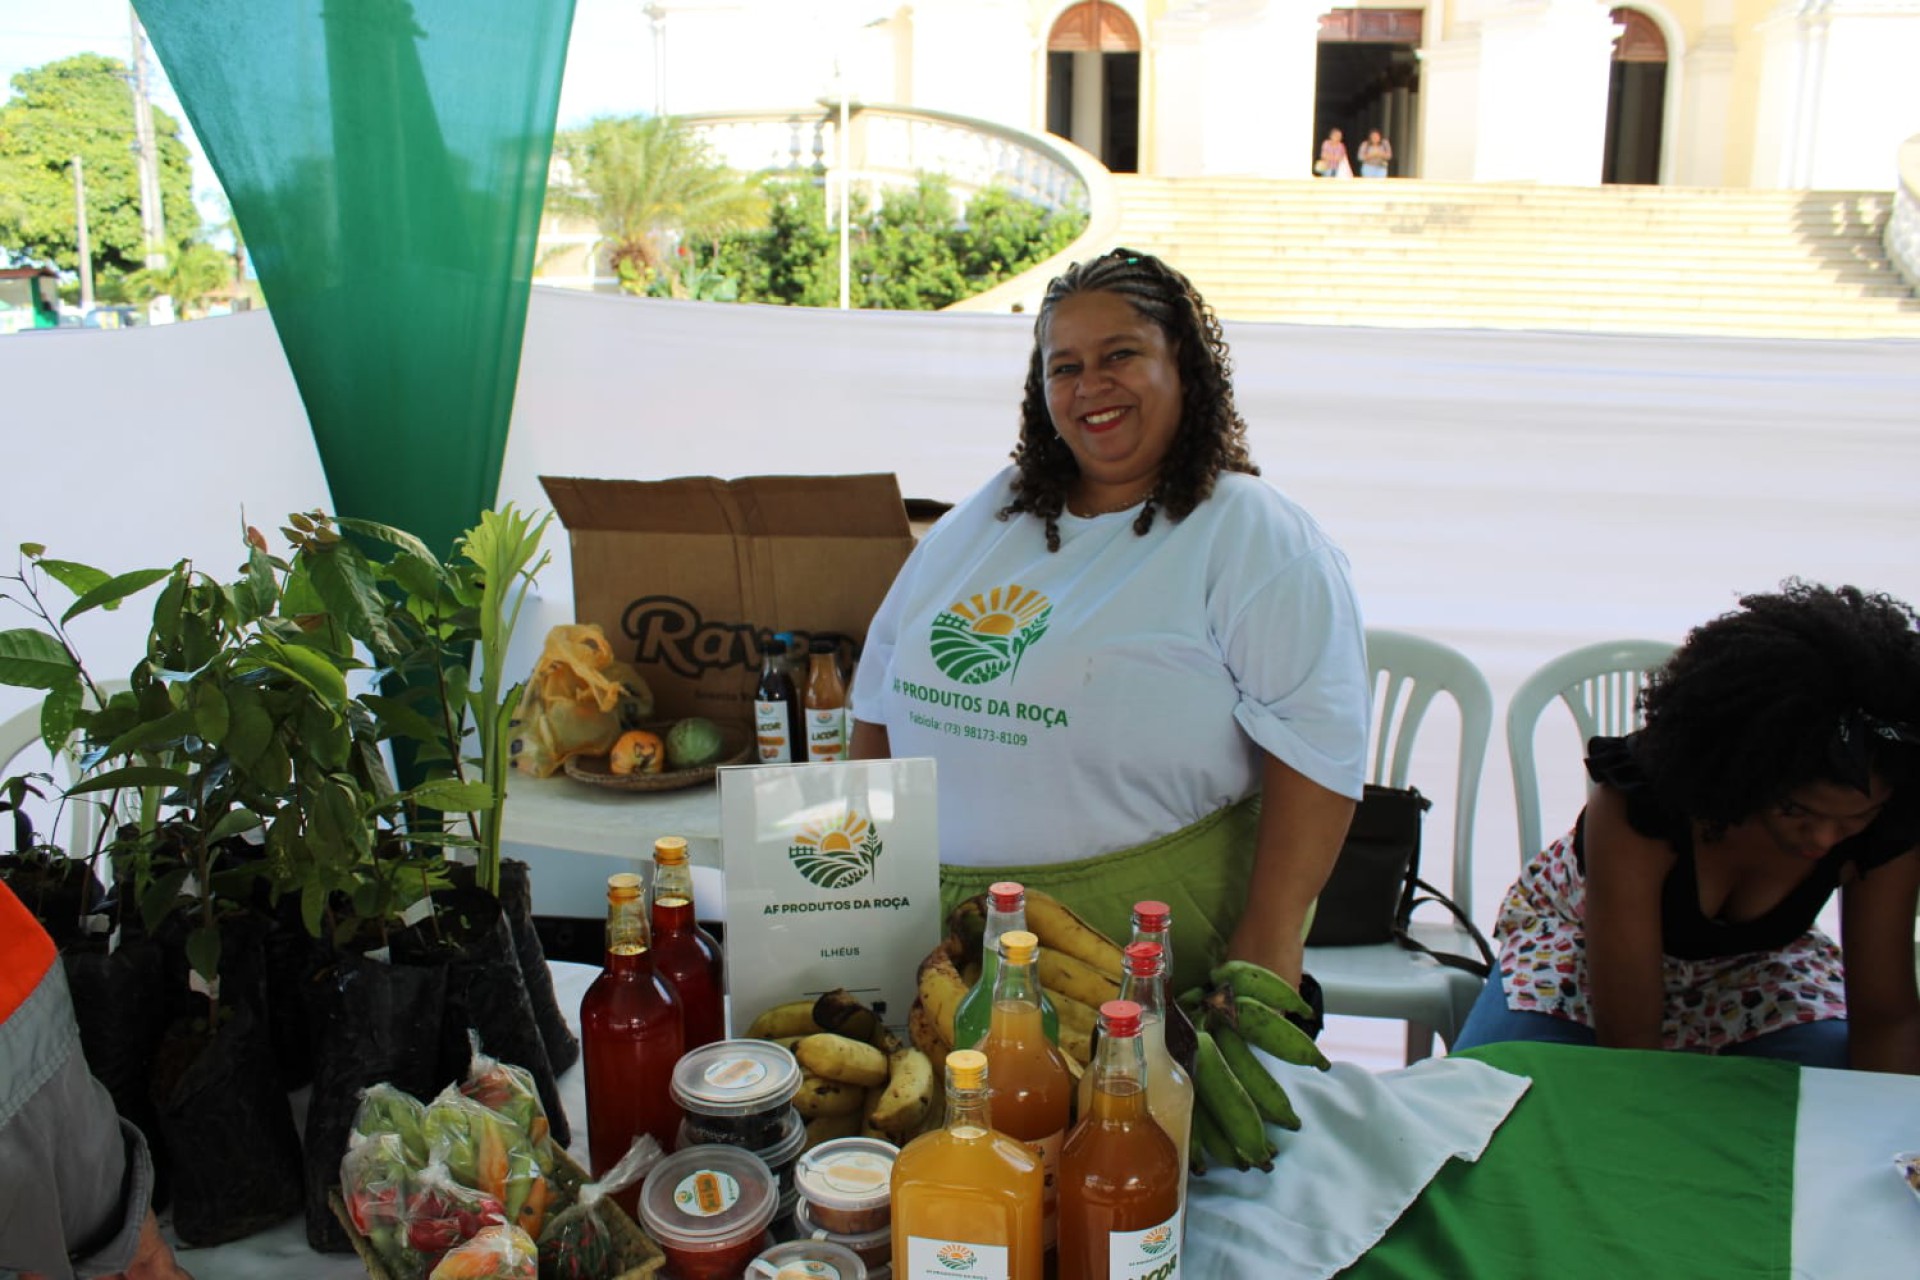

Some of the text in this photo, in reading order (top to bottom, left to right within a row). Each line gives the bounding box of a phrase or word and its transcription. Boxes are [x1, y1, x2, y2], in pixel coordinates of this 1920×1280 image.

[903, 681, 982, 713] PRODUTOS
[987, 699, 1010, 717] DA
[1016, 703, 1068, 728] ROÇA
[944, 722, 961, 736] (73)
[964, 725, 1028, 746] 98173-8109
[764, 897, 910, 915] AF PRODUTOS DA ROÇA
